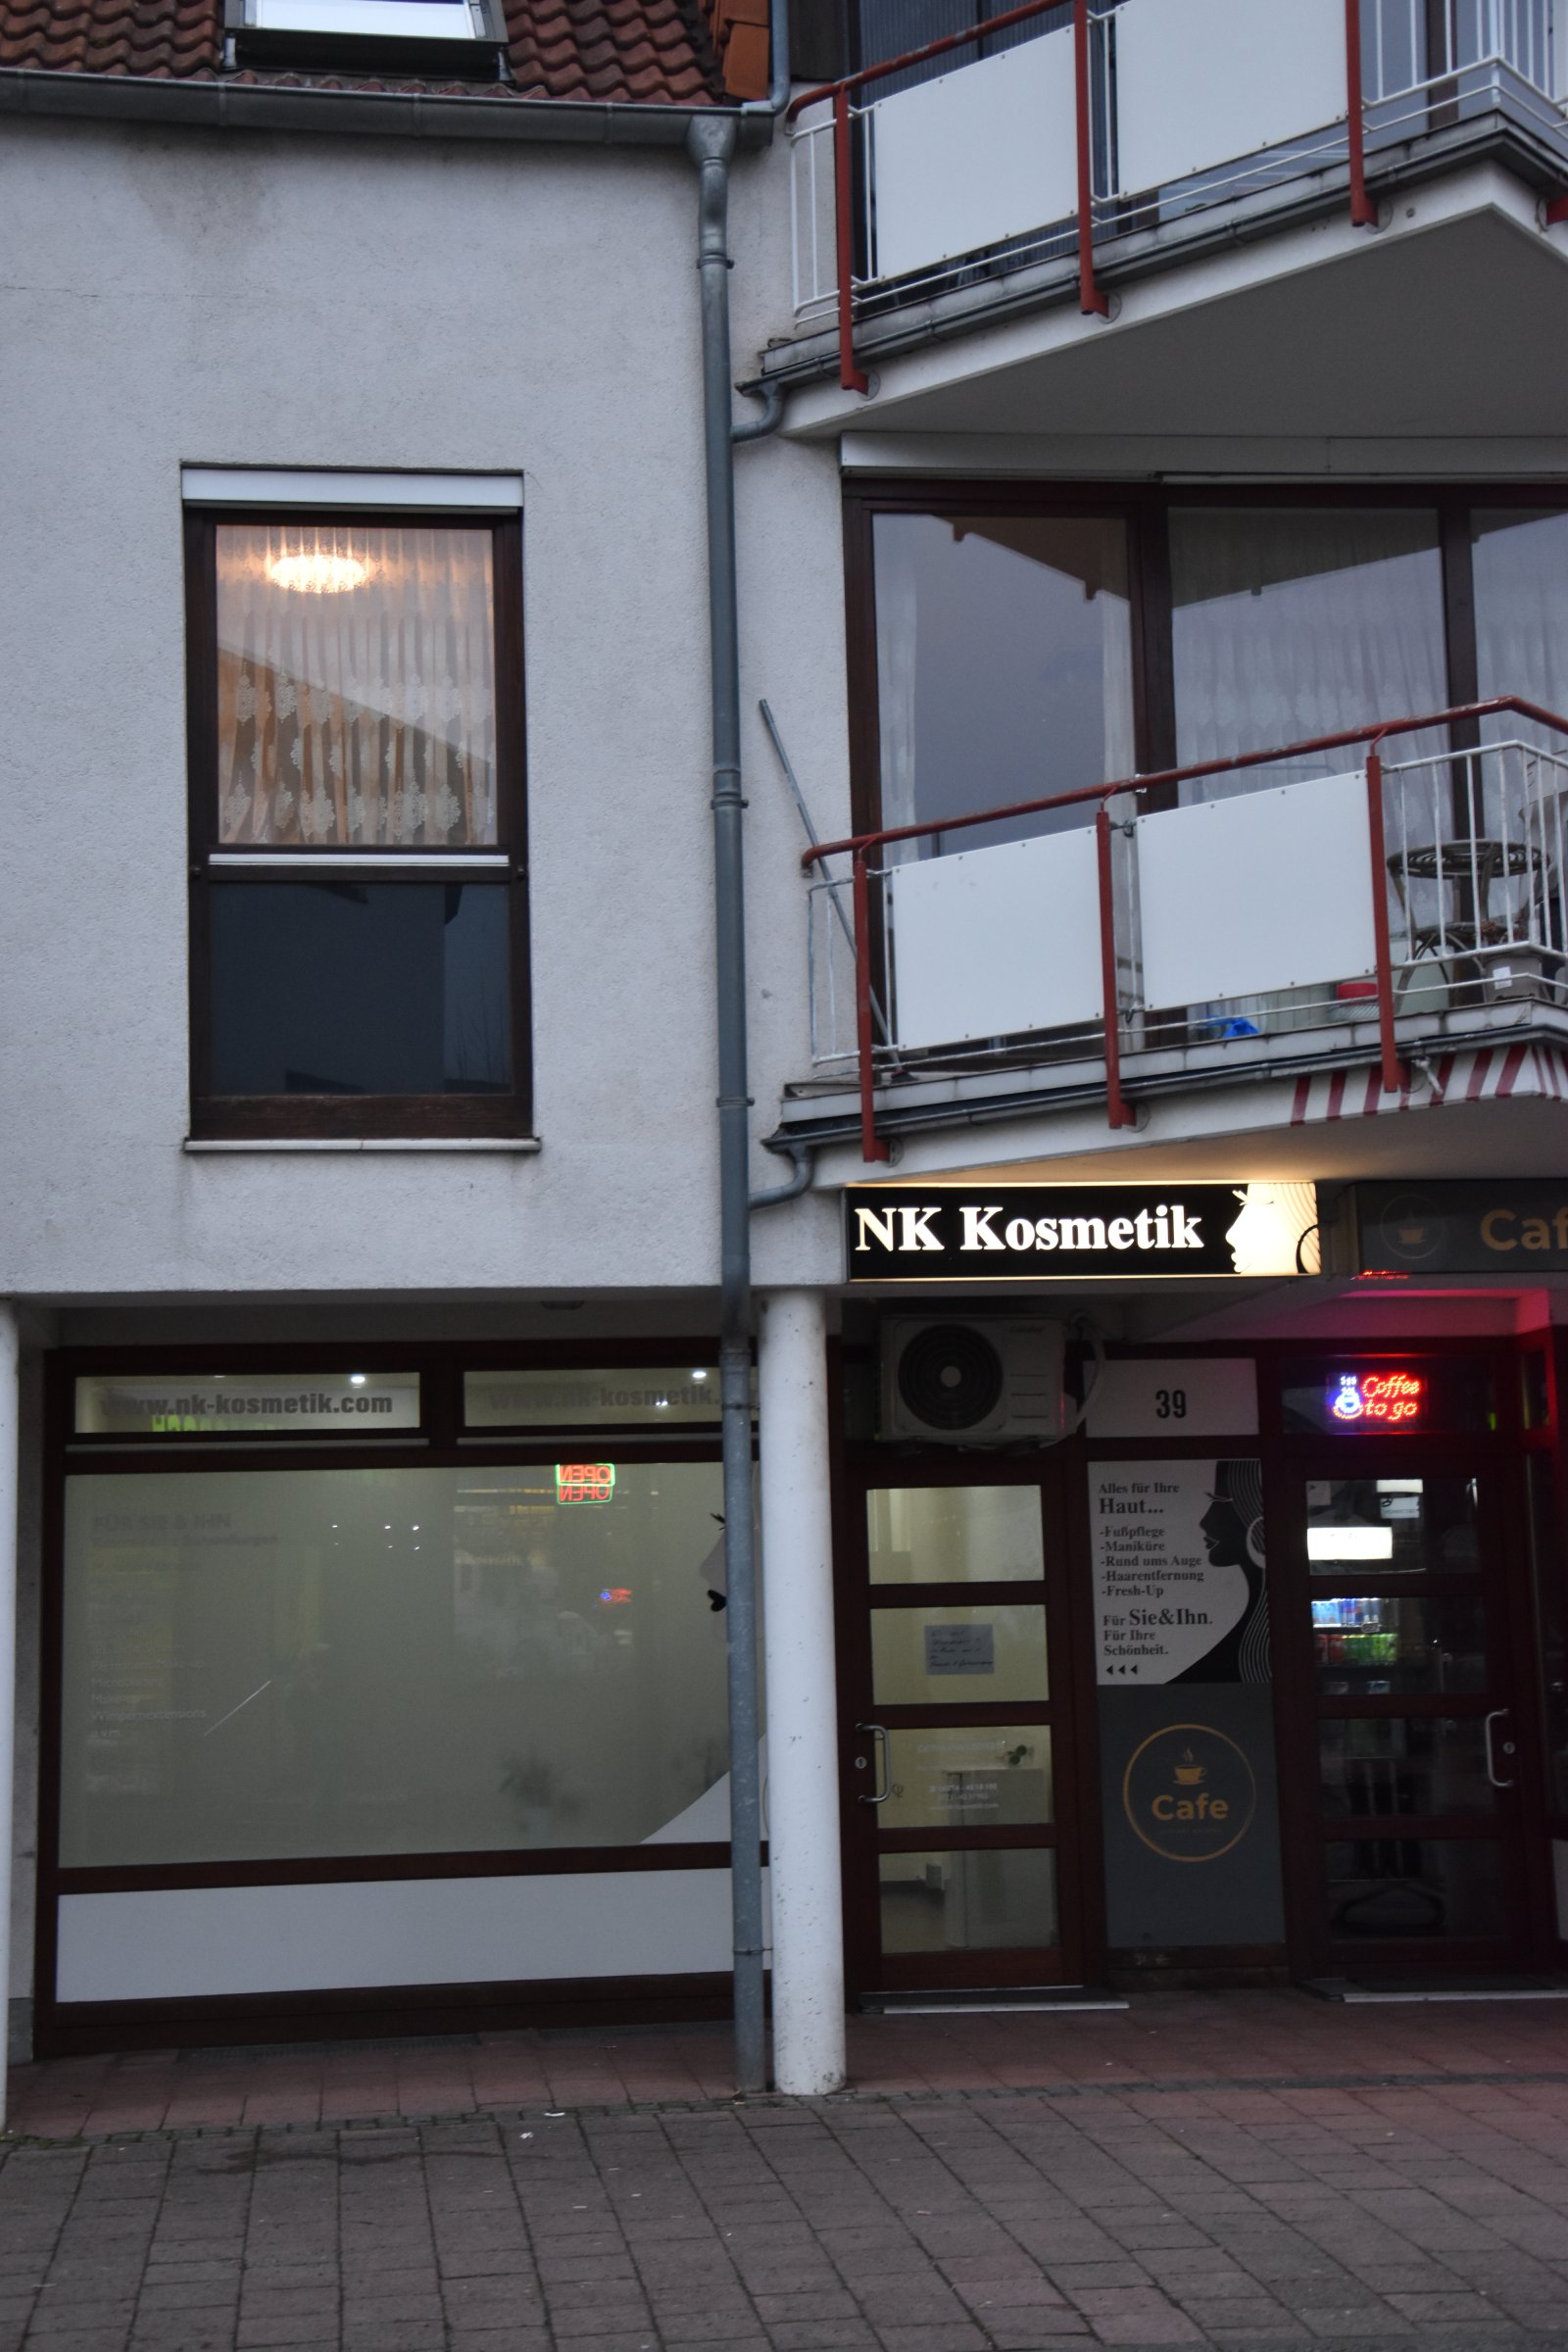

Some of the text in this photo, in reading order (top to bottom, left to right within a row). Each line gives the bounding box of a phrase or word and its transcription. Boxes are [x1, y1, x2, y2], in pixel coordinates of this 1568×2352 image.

[854, 1202, 1205, 1252] NK Kosmetik
[1362, 1375, 1420, 1397] Coffee
[101, 1394, 393, 1417] www.nk-kosmetik.com
[1154, 1389, 1187, 1421] 39
[1364, 1398, 1418, 1421] to go
[1099, 1482, 1180, 1494] Alles für Ihre
[1099, 1497, 1164, 1514] Haut...
[1100, 1526, 1165, 1540] -Fußpflege
[1101, 1541, 1165, 1552] -Maniküre
[1101, 1555, 1202, 1568] -Rund ums Auge
[1102, 1570, 1204, 1582] -Haarentfernung
[1102, 1585, 1164, 1598] -Fresh-Up
[1103, 1607, 1213, 1627] Für Sie&Ihn.
[1103, 1630, 1156, 1642] Für Ihre
[1103, 1643, 1169, 1656] Schönheit.
[1152, 1792, 1229, 1821] Cafe
